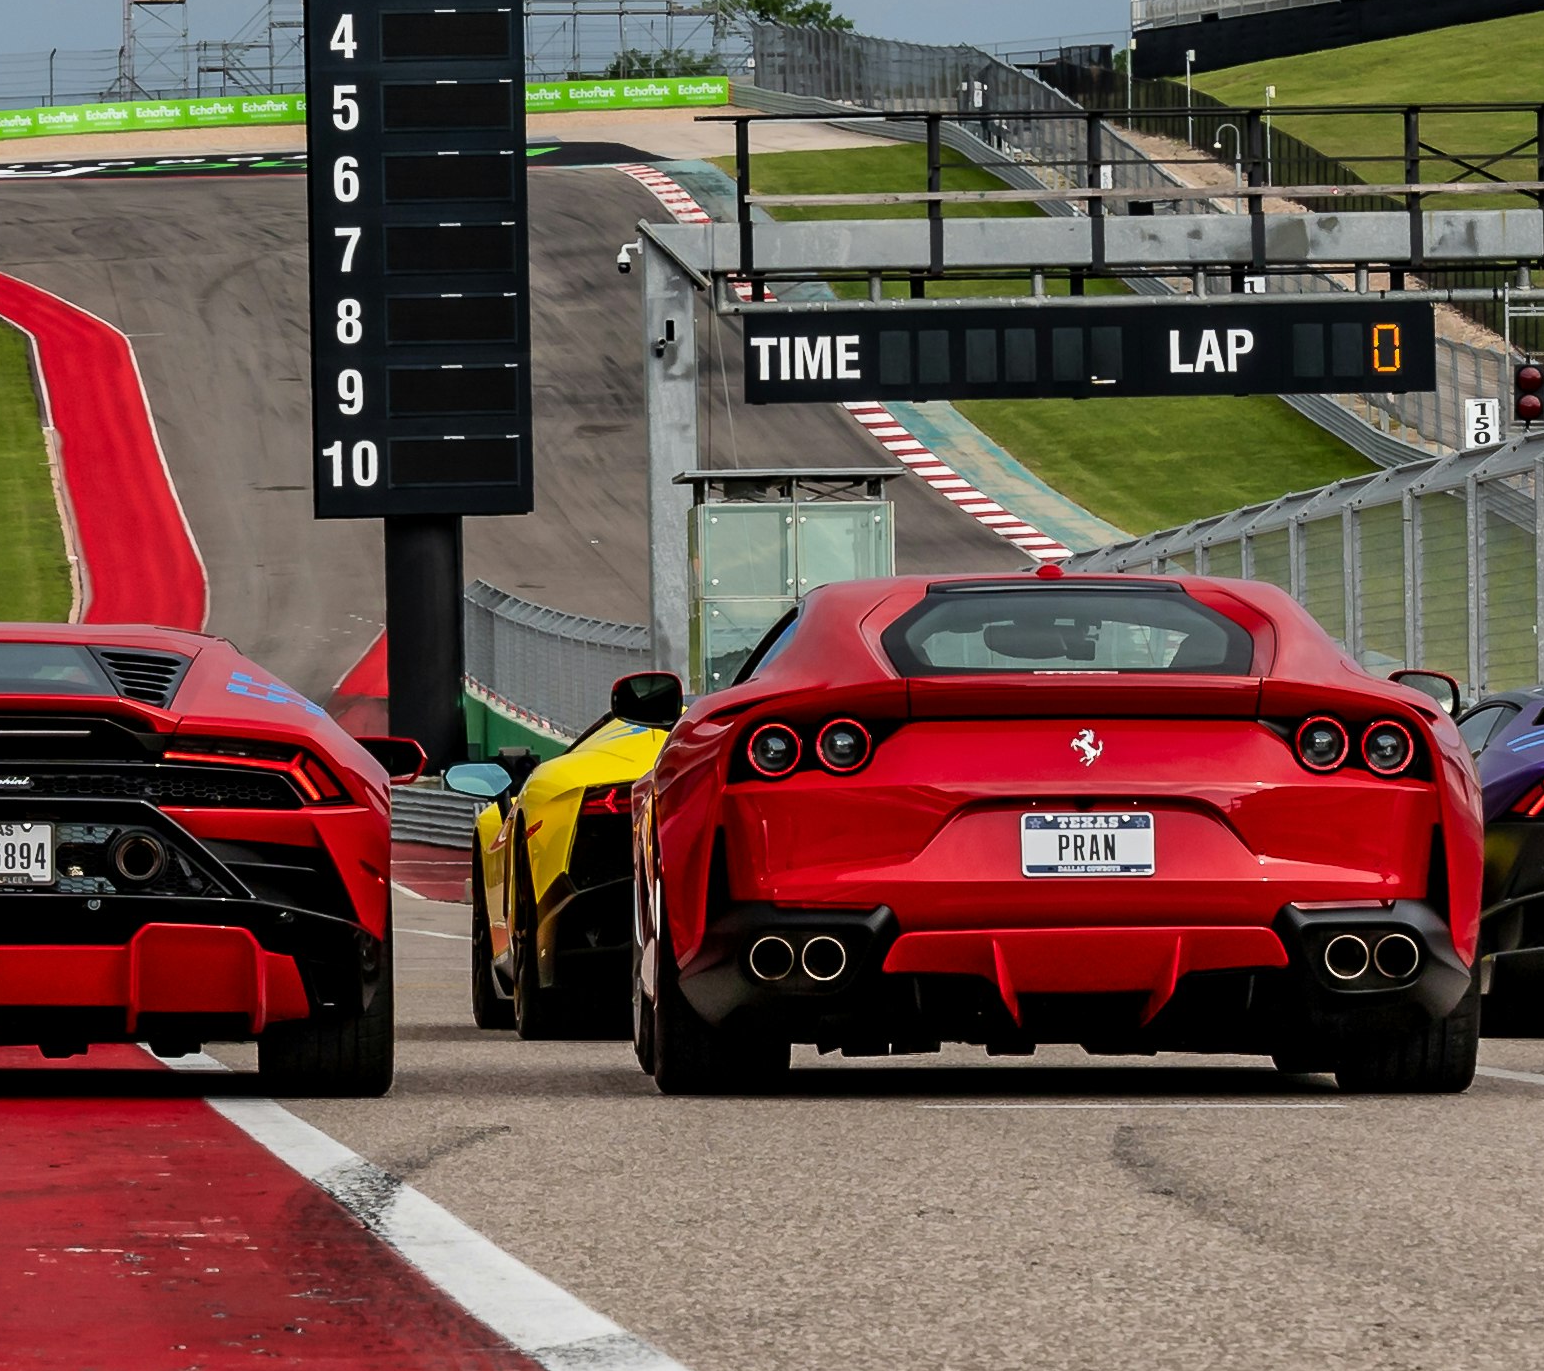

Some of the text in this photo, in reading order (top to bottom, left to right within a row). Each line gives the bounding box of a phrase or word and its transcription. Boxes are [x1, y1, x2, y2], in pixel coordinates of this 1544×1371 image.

[329, 13, 358, 59] 4
[242, 100, 289, 113] EchoPark
[569, 85, 616, 99] EchoPark
[623, 83, 670, 97] EchoPark
[678, 82, 724, 96] EchoPark
[38, 111, 79, 125] EchoPark
[85, 107, 129, 120] EchoPark
[135, 105, 181, 118] EchoPark
[189, 102, 235, 116] EchoPark
[332, 84, 360, 131] 5
[333, 155, 360, 203] 6
[334, 226, 362, 273] 7
[336, 298, 363, 345] 8
[750, 334, 861, 381] TIME
[1169, 323, 1401, 374] LAP 0
[337, 368, 364, 415] 9
[1473, 402, 1491, 445] 150
[322, 440, 379, 487] 10
[1056, 816, 1120, 829] TEXAS
[1057, 833, 1117, 862] PRAN
